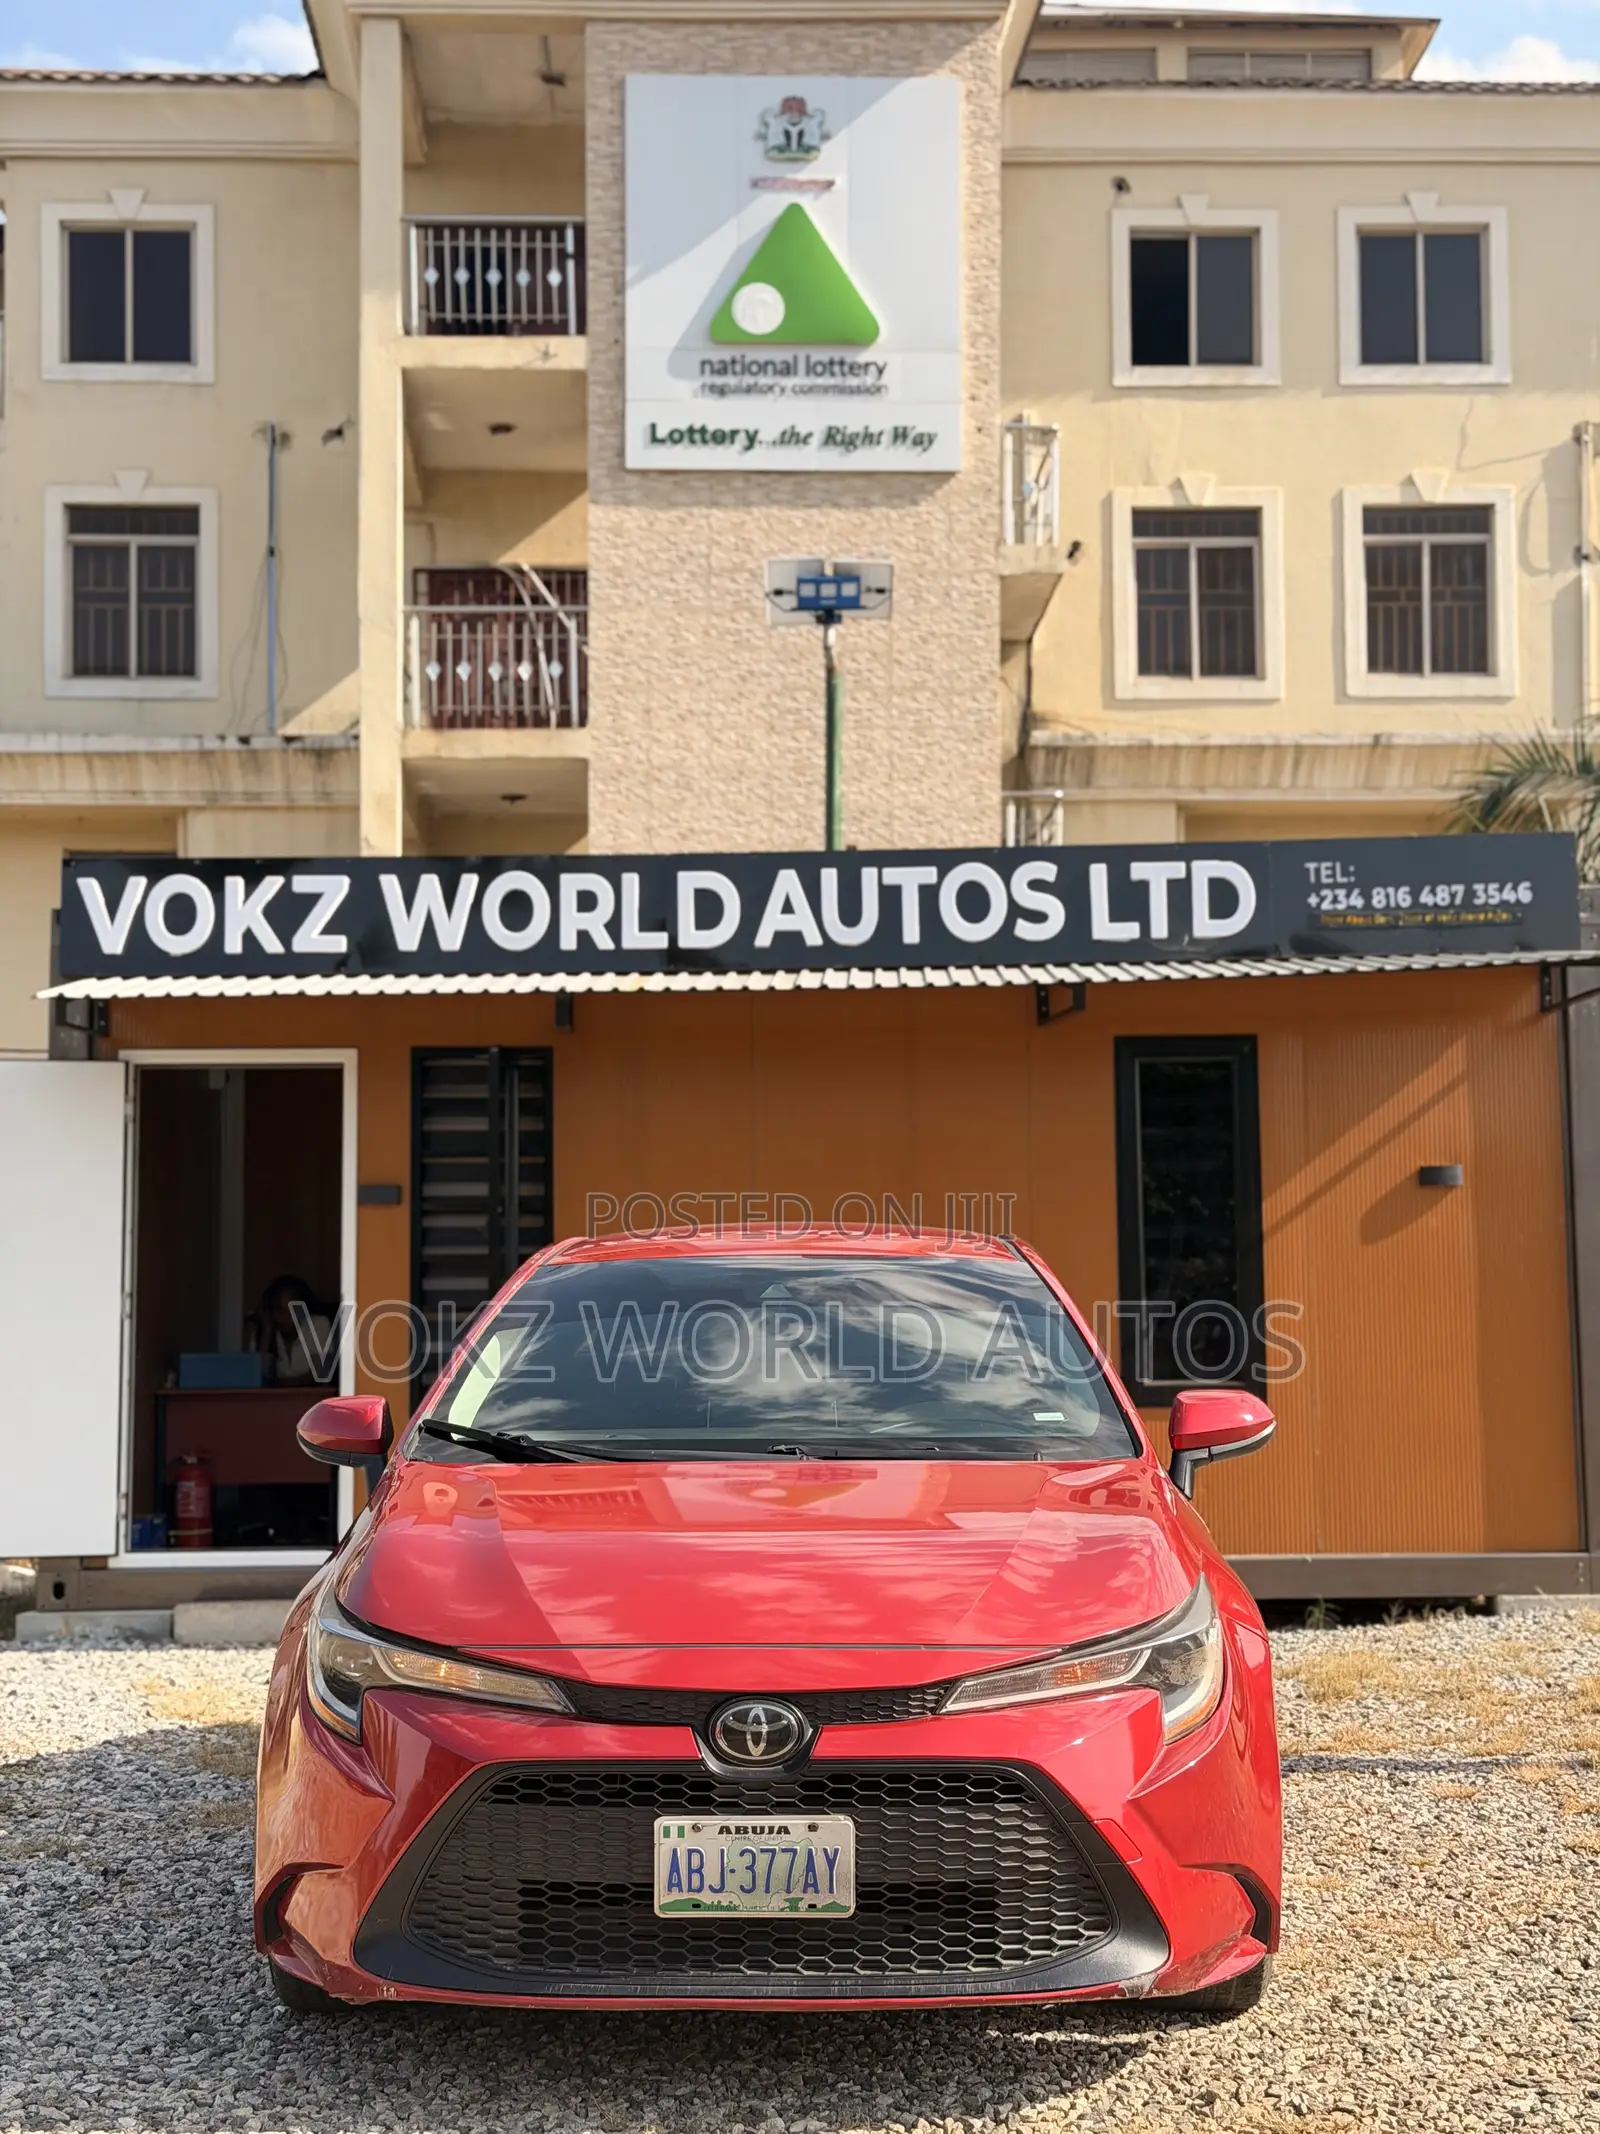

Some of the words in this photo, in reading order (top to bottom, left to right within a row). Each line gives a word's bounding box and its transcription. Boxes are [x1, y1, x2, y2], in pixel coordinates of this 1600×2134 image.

[700, 354, 798, 377] national
[804, 354, 888, 381] lottery
[700, 382, 785, 397] regulatory
[790, 383, 887, 396] commission
[822, 425, 884, 451] Right
[890, 425, 938, 451] Way
[1304, 861, 1356, 884] TEL:
[76, 874, 351, 956] VOKZ
[378, 870, 742, 952] WORLD
[753, 861, 1065, 948] AUTOS
[1089, 859, 1257, 942] LTD
[1306, 888, 1365, 911] +234
[1371, 886, 1412, 909] 816
[1419, 884, 1465, 907] 487
[1472, 881, 1533, 905] 3546
[717, 1825, 791, 1835] ABUJA
[667, 1847, 841, 1895] ABJ-377AY
